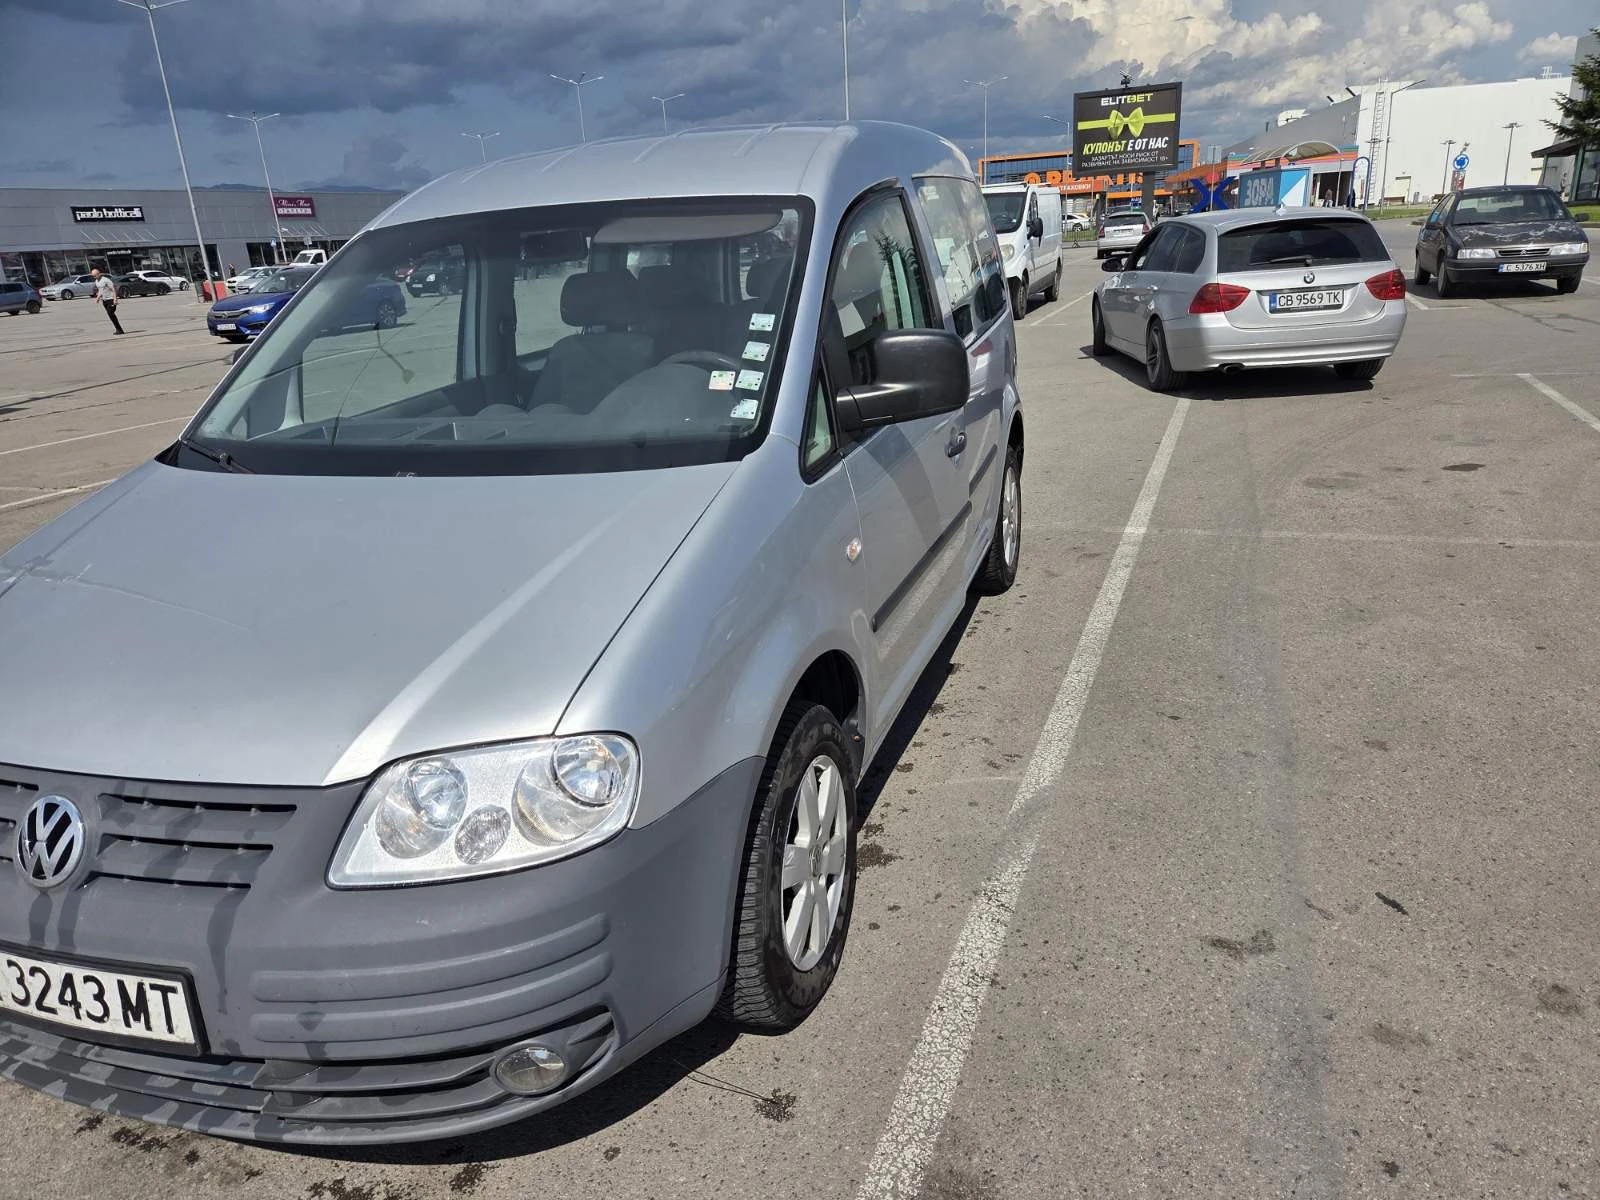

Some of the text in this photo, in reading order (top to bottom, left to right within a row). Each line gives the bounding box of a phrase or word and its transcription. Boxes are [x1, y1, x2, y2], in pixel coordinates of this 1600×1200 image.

[1100, 93, 1154, 106] ELITBET
[1082, 136, 1169, 156] КУПОНЪТ Е ОТ НАС
[1059, 183, 1092, 192] ТРАХОВКИ
[1244, 176, 1274, 206] ЗОРА
[75, 208, 103, 221] paolo
[1278, 291, 1341, 307] CB 9569 TK
[6, 959, 178, 1035] 3243 MT
